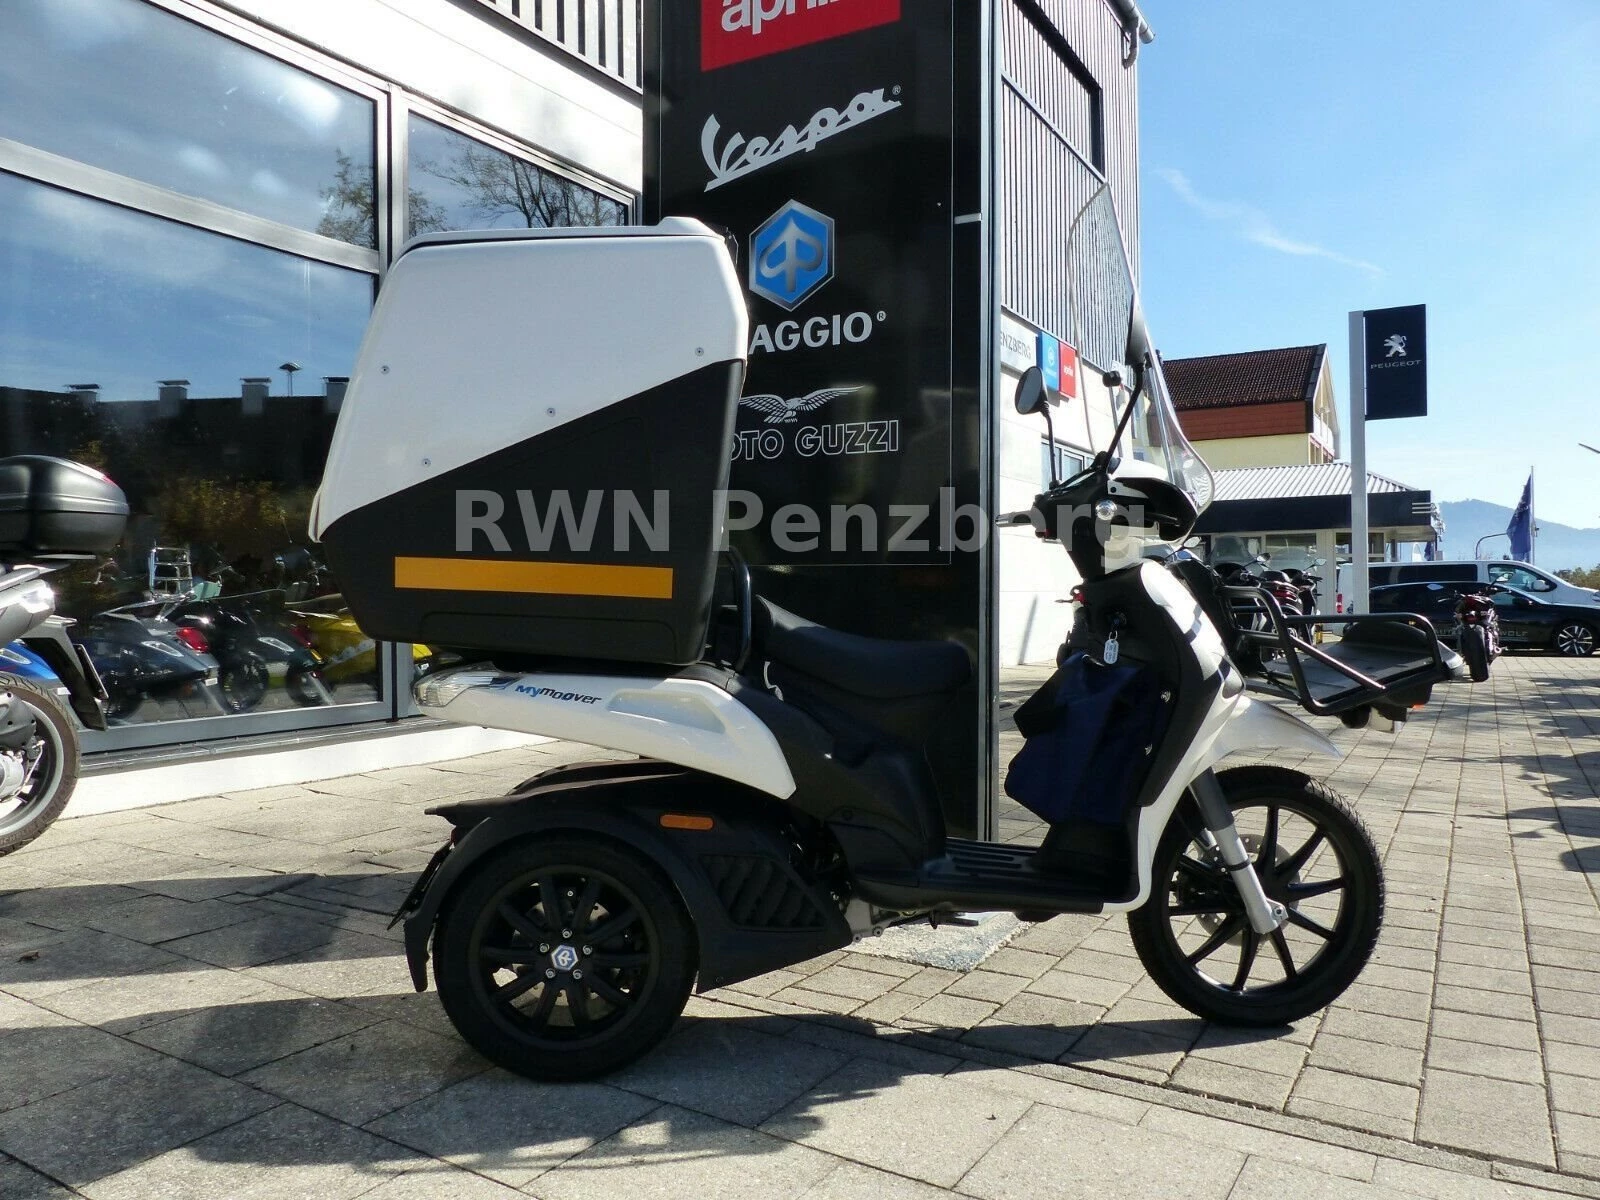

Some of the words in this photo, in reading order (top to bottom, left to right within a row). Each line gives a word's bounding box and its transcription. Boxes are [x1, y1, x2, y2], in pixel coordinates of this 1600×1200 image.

[701, 88, 901, 193] Vespa
[748, 311, 873, 355] AGGIO
[1370, 360, 1422, 369] PEUGEOT
[731, 428, 785, 461] TO
[794, 419, 899, 457] GUZZI
